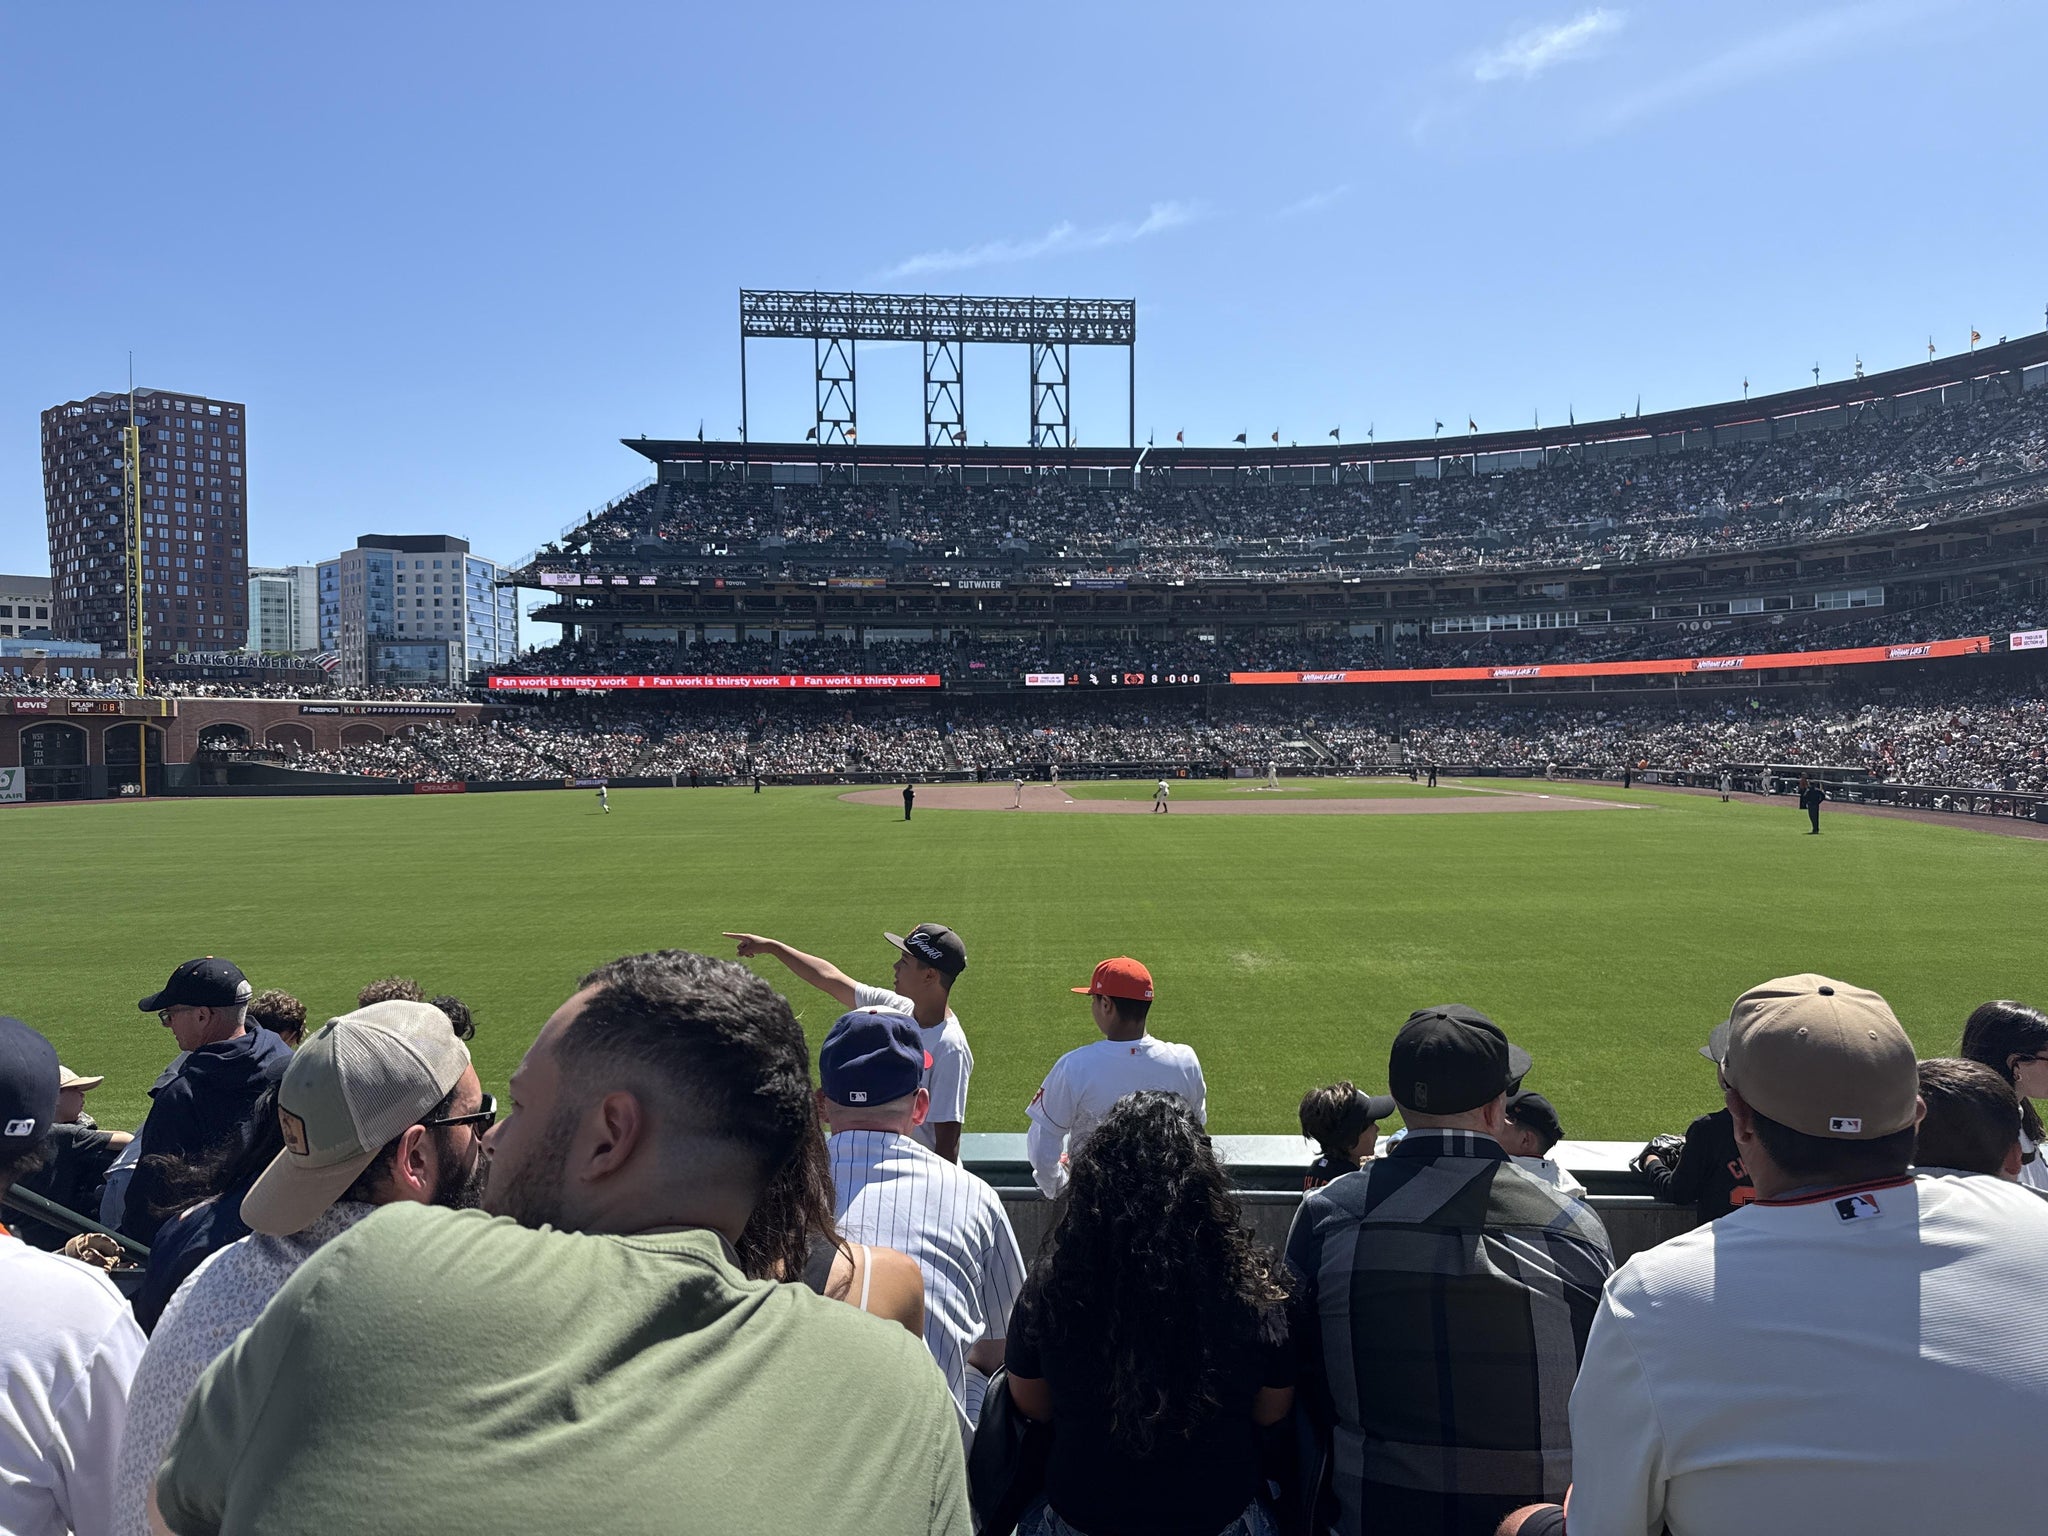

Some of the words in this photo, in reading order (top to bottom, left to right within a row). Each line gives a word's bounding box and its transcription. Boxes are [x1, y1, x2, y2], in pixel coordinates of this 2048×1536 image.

[127, 484, 136, 549] CHIKIN
[130, 556, 137, 578] IZ
[958, 580, 1001, 589] CUTWATER
[130, 586, 138, 629] FARE
[176, 653, 221, 667] BANK
[224, 655, 245, 668] OF
[246, 656, 312, 670] AMERICA
[496, 677, 517, 686] Fan
[519, 677, 548, 686] work
[550, 677, 559, 686] is
[561, 677, 598, 688] thirsty
[600, 677, 628, 686] work
[653, 677, 673, 686] Fan
[675, 677, 703, 686] work
[705, 677, 714, 686] is
[715, 677, 751, 687] thirsty
[752, 677, 780, 685] work
[804, 677, 823, 685] Fan
[824, 677, 852, 685] work
[854, 676, 863, 685] is
[864, 676, 898, 687] thirsty
[899, 676, 926, 685] work
[1111, 675, 1118, 684] 5
[1151, 674, 1158, 684] 8
[1169, 674, 1176, 684] 0
[1181, 674, 1188, 684] 0
[1193, 674, 1200, 684] 0
[120, 784, 141, 794] 309
[907, 932, 944, 960] Giants
